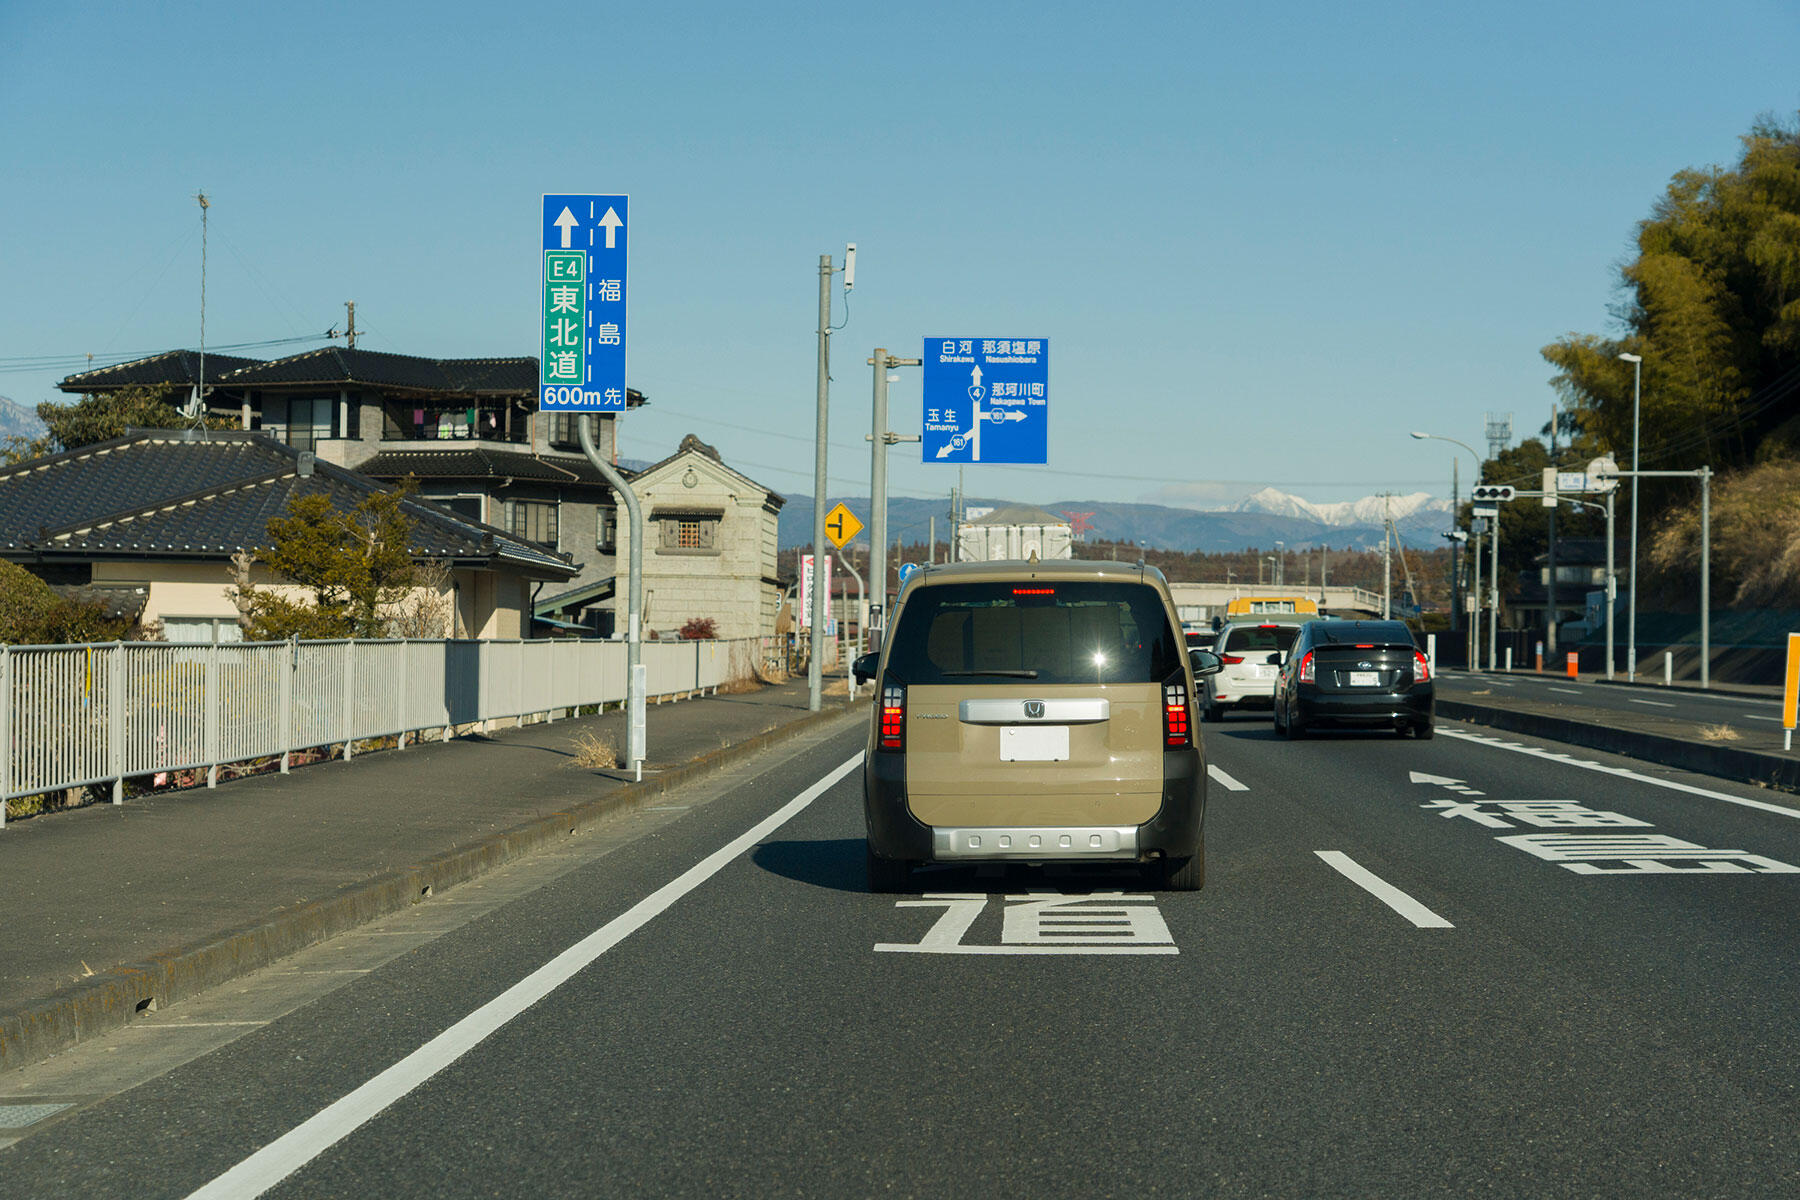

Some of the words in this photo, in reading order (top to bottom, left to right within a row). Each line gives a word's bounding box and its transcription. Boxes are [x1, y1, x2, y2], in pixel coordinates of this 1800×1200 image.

[553, 260, 577, 277] E4
[598, 279, 622, 346] 福島
[549, 285, 580, 379] 東北道
[942, 340, 973, 354] 白河
[982, 340, 1041, 355] 那須塩原
[939, 355, 975, 363] Shirakawa
[992, 382, 1045, 397] 那珂川町
[928, 408, 957, 422] 玉生
[925, 423, 959, 433] Tamanyu
